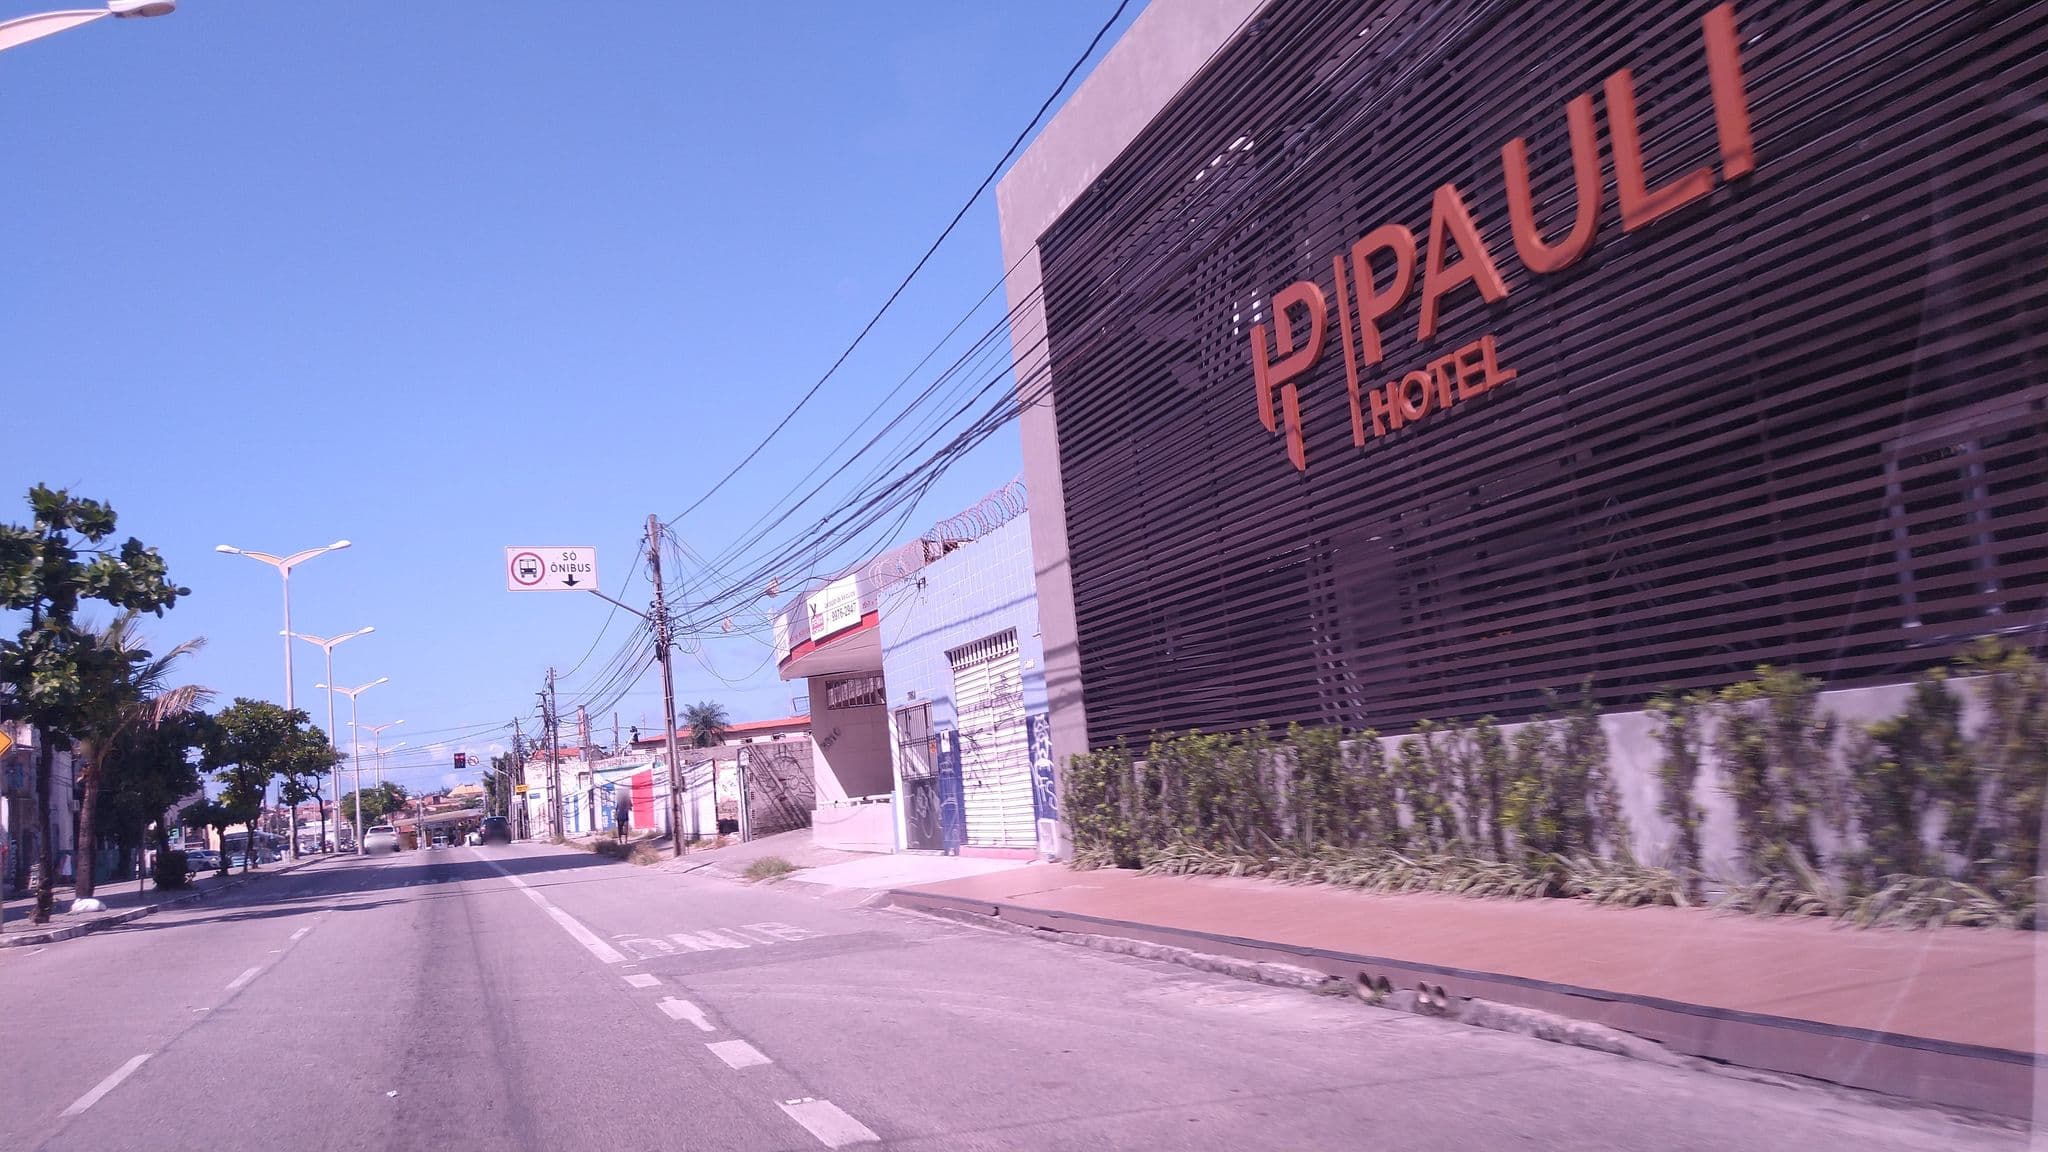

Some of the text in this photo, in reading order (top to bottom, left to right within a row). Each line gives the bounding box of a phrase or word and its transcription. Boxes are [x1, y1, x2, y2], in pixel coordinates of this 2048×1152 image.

[1351, 3, 1755, 367] PAULI
[1369, 335, 1518, 437] HOTEL
[550, 561, 592, 573] ÔNIBUS
[562, 550, 577, 561] SÓ
